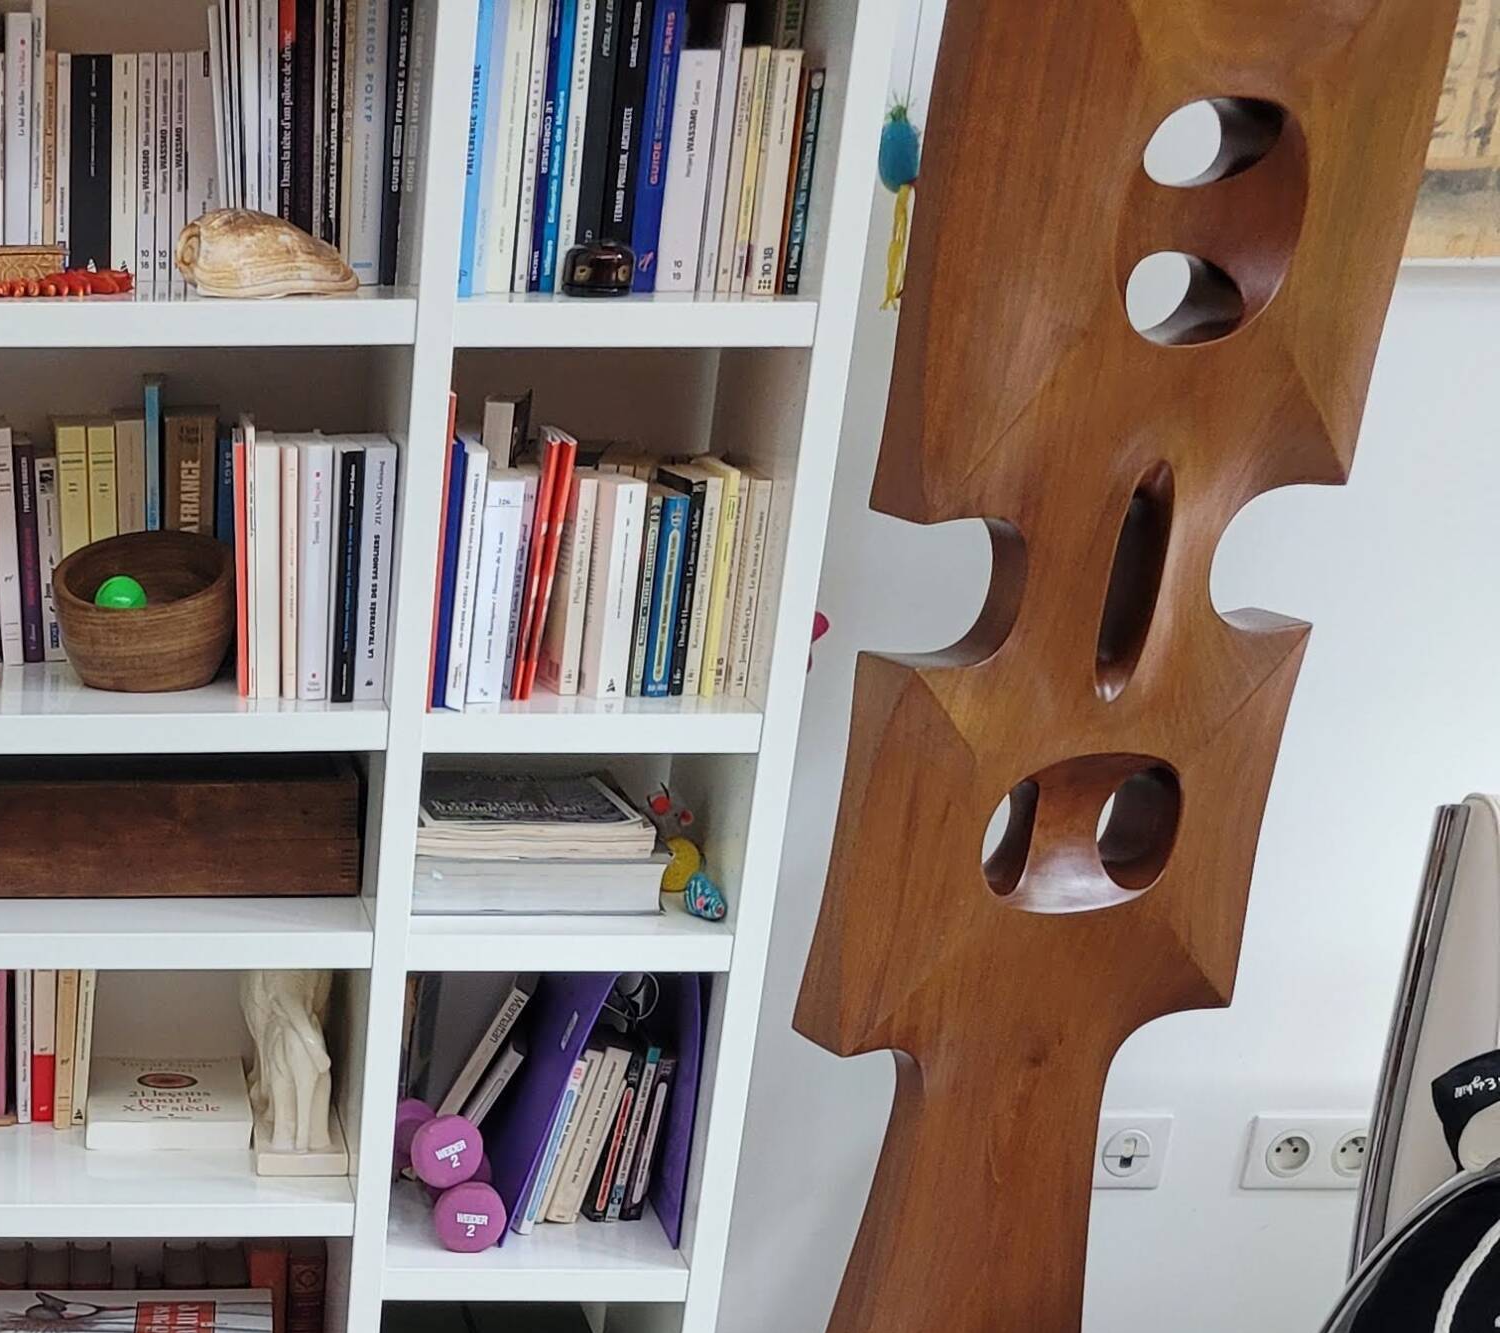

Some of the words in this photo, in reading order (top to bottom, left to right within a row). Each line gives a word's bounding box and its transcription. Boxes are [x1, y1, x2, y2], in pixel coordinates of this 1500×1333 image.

[400, 7, 409, 32] 2014
[283, 30, 292, 60] drone
[579, 16, 590, 64] ASSISES
[664, 12, 675, 54] PARIS
[399, 35, 407, 67] PARIS
[282, 62, 292, 75] de
[577, 69, 585, 90] LES
[281, 76, 292, 105] pilote
[364, 74, 374, 122] POLYP
[396, 81, 405, 122] FRANCE
[281, 107, 291, 129] d'un
[545, 100, 553, 114] LE
[281, 131, 291, 148] tête
[686, 109, 697, 152] WASSMO
[160, 129, 168, 170] WASSMO
[175, 128, 183, 168] WASSMO
[281, 150, 291, 160] la
[528, 148, 534, 163] DE
[540, 116, 552, 173] CORBUSIER
[142, 150, 150, 190] WASSMO
[280, 162, 291, 187] Dans
[391, 159, 399, 192] GUIDE
[613, 191, 625, 222] FERNAND
[620, 108, 632, 149] ARCHITECTE
[649, 142, 662, 185] GUIDE
[548, 179, 558, 223] Eduardo
[141, 260, 149, 269] 18
[159, 250, 167, 258] 10
[159, 261, 167, 269] 18
[673, 260, 682, 268] 10
[762, 247, 774, 260] 18
[760, 263, 771, 276] 10
[374, 492, 384, 525] ZHANG
[371, 534, 381, 580] SANGLIERS
[370, 583, 378, 599] DES
[368, 602, 377, 646] TRAVERSÉE
[367, 648, 374, 659] LA
[489, 994, 524, 1043] Manhattan
[435, 1140, 467, 1160] WEIDER
[449, 1155, 461, 1168] 2
[456, 1213, 488, 1225] WEIDER
[465, 1225, 476, 1237] 2
